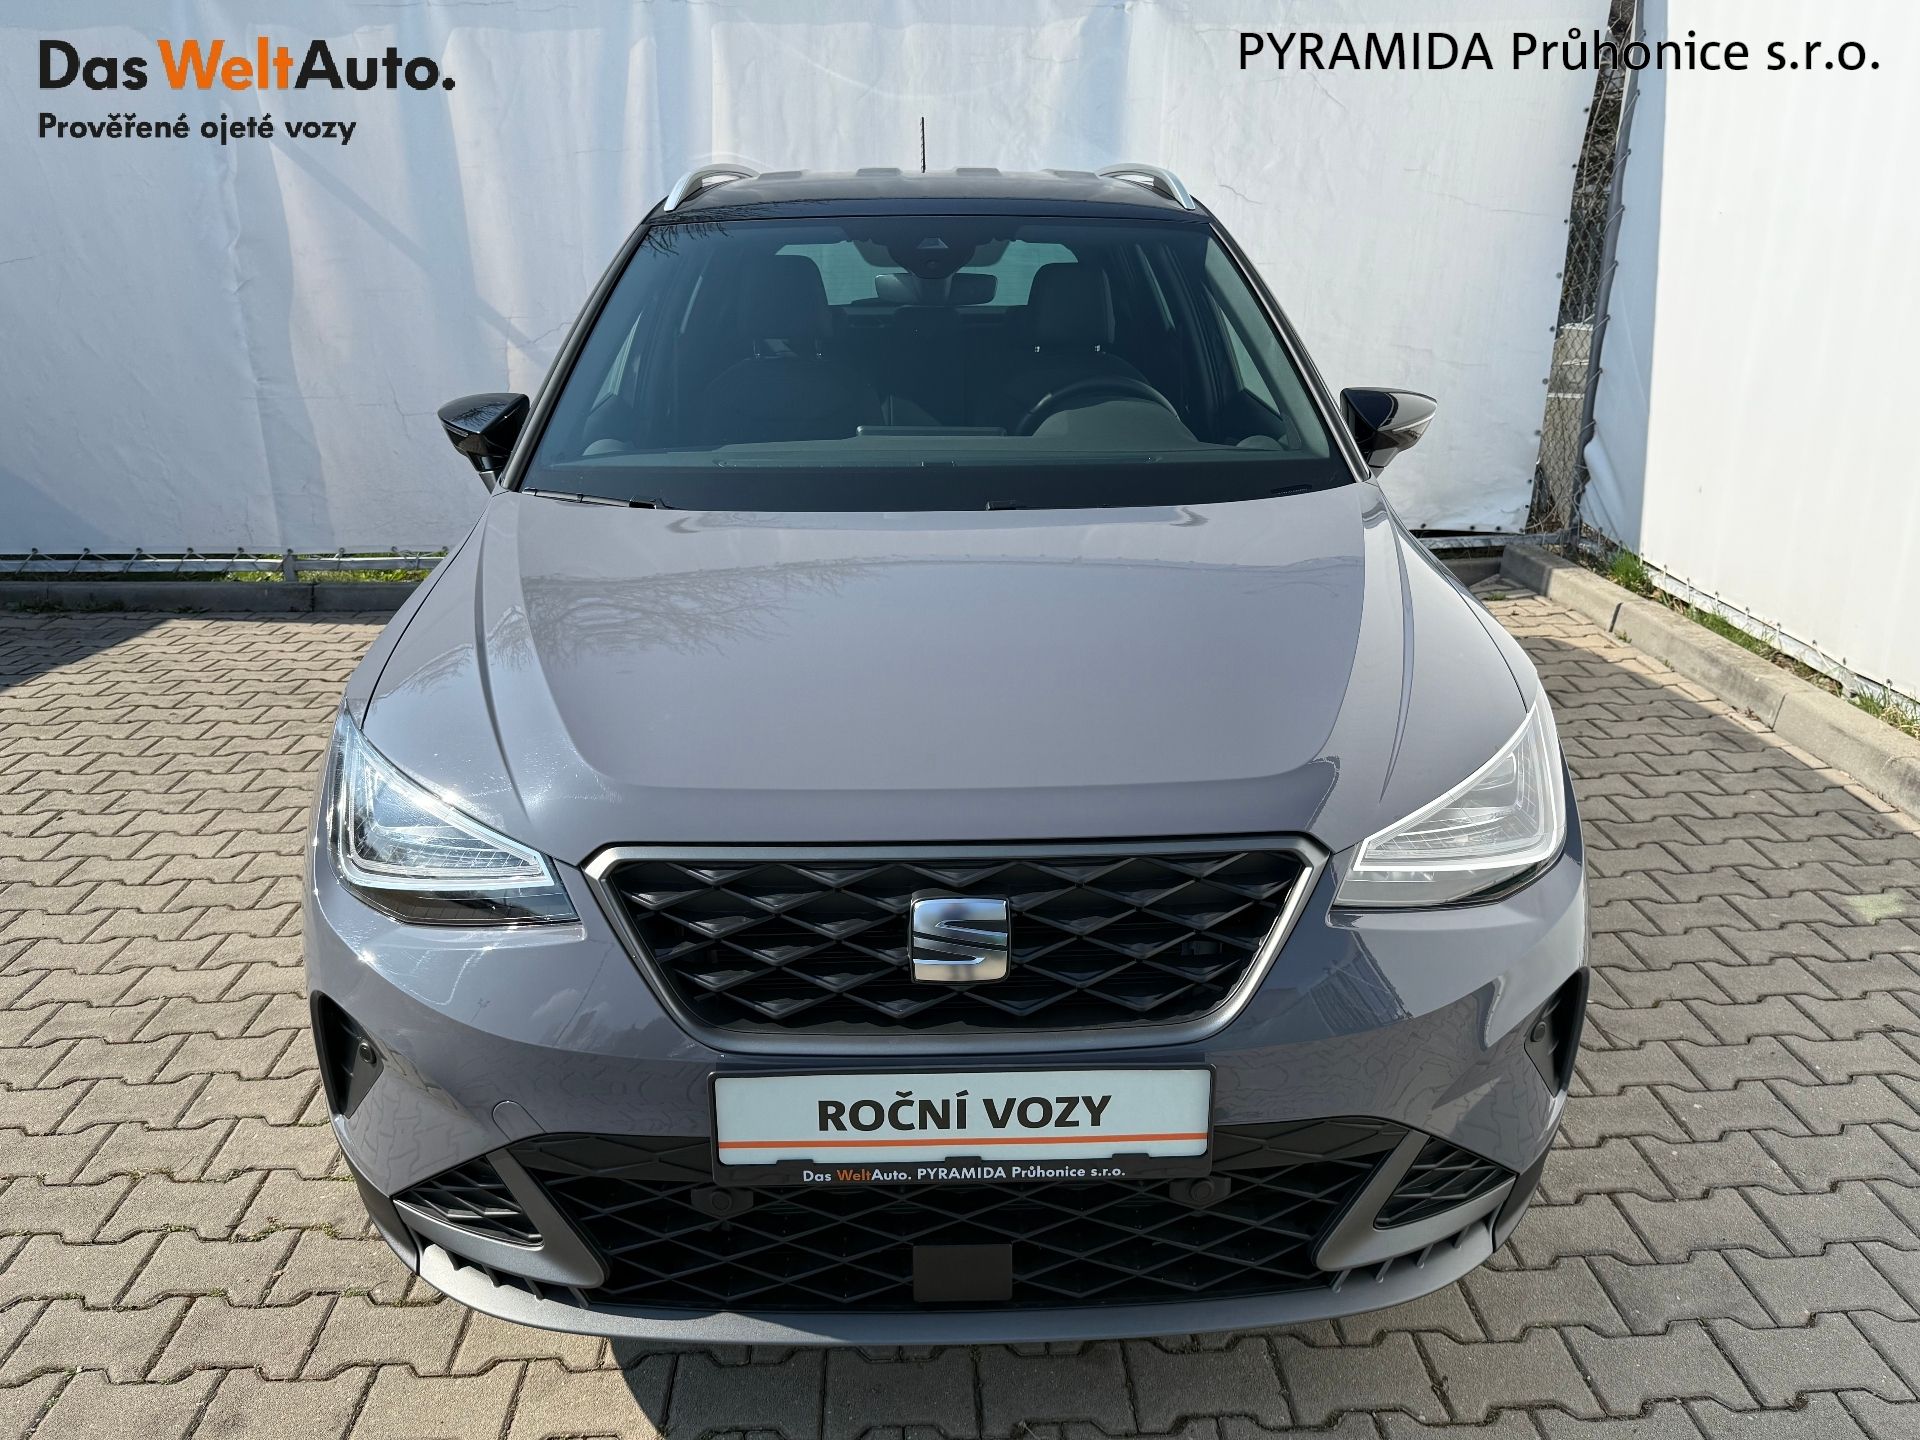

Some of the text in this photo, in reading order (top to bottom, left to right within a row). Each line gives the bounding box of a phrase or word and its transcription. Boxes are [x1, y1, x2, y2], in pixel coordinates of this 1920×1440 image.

[817, 1089, 1112, 1132] ROČNÍ VOZY
[803, 1165, 1126, 1182] Das WeltAuto. PYRAMIDA Průhonice s.r.o.
